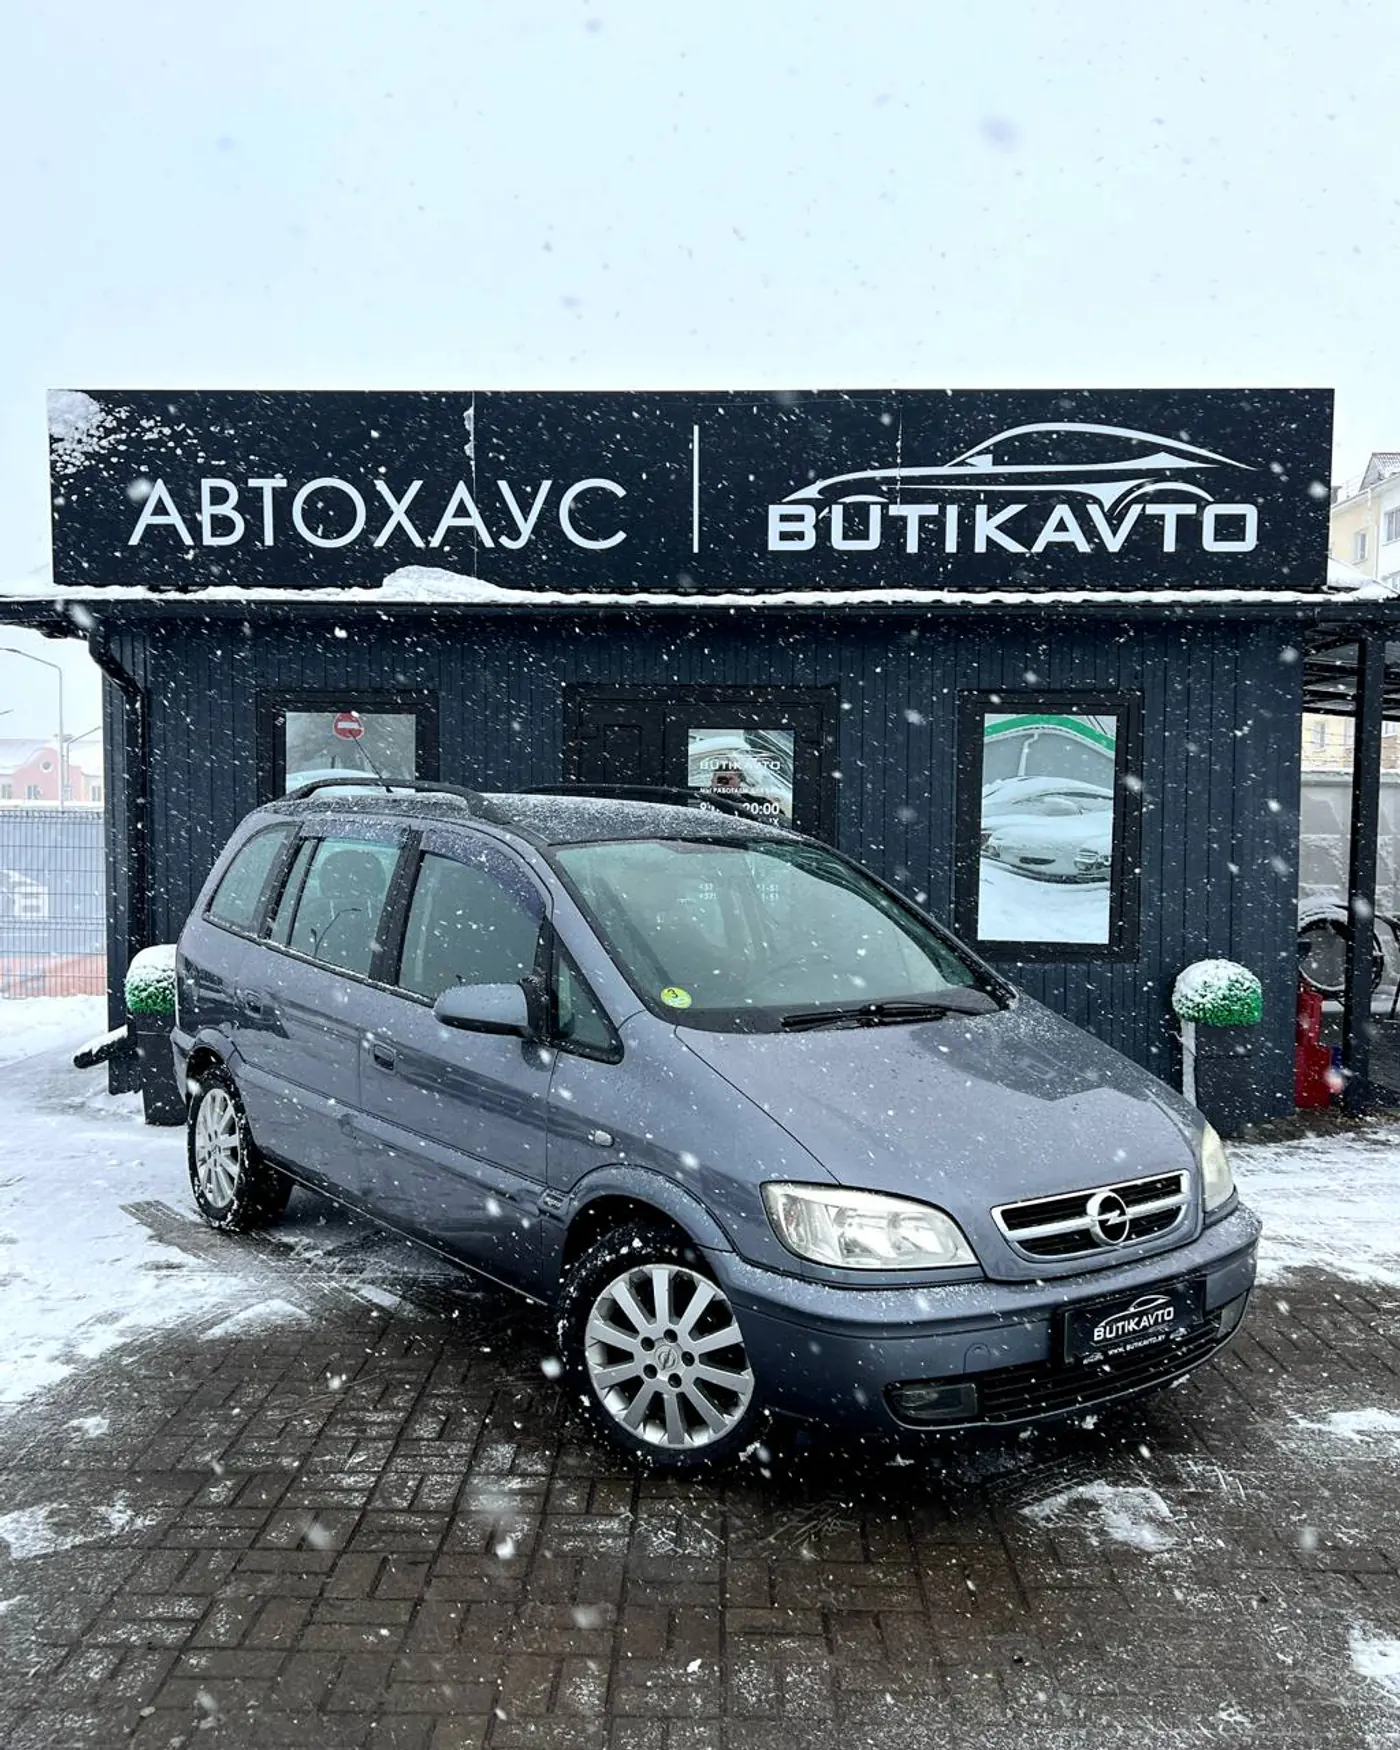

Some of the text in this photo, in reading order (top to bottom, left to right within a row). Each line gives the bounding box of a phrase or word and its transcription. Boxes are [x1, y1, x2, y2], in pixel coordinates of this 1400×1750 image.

[128, 477, 627, 550] АВТОХАУС
[767, 503, 1258, 553] BUTIKAVTO
[1093, 1306, 1175, 1341] BUTIKAVTO
